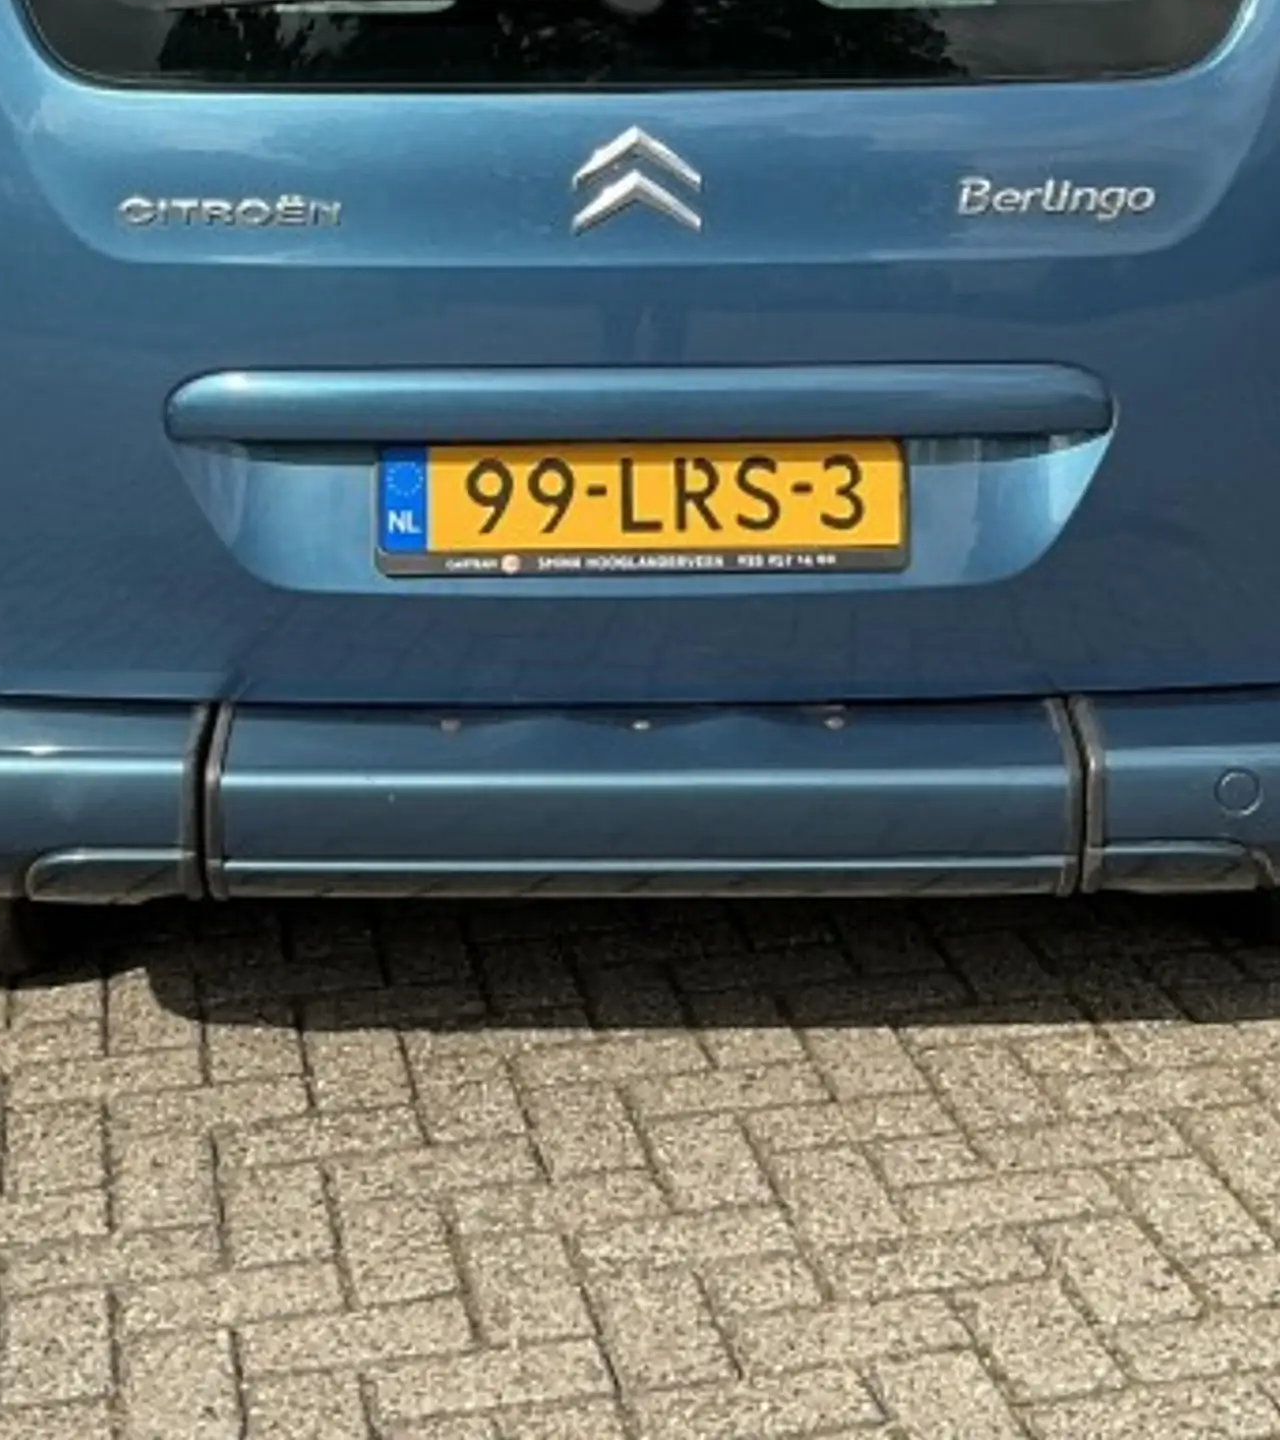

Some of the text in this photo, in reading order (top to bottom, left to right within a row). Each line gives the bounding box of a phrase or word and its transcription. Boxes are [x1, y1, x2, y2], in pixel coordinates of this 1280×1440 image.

[117, 193, 342, 227] CITROËN
[957, 175, 1157, 223] Berlingo
[465, 452, 866, 535] 99-LRS-3
[387, 510, 421, 533] NL
